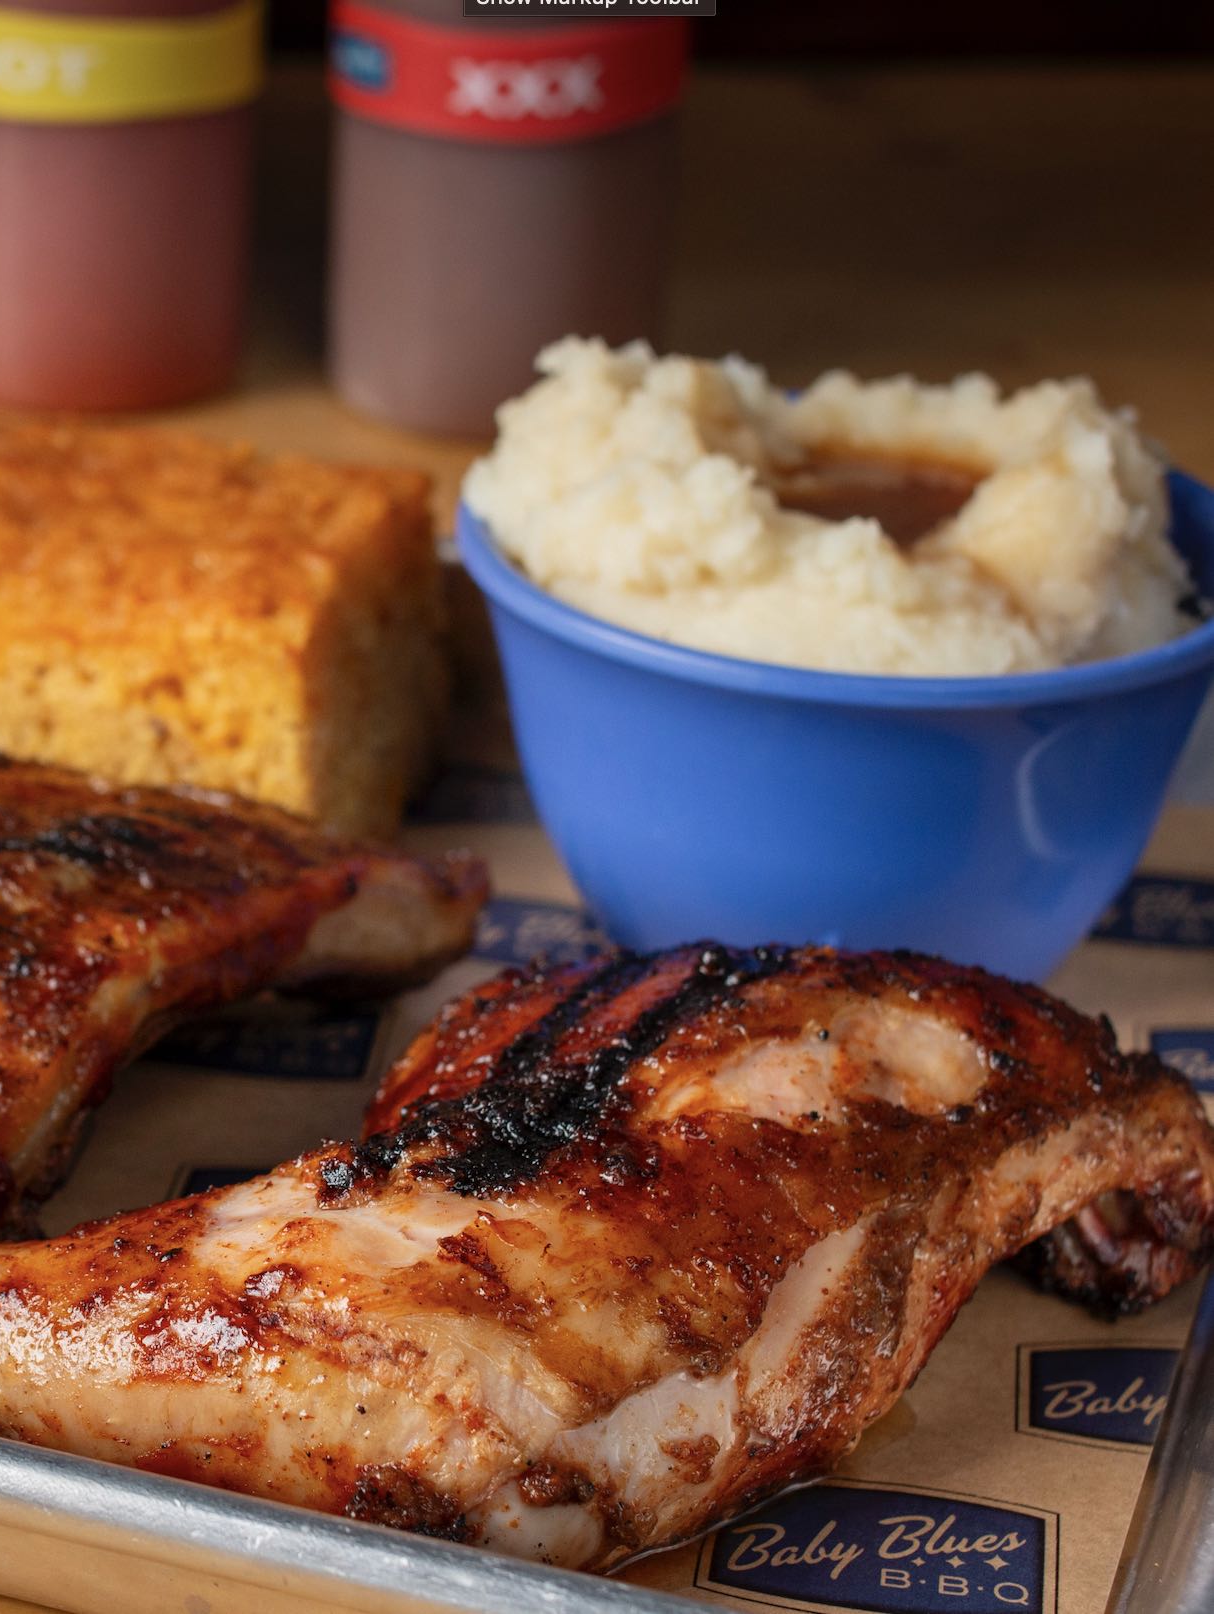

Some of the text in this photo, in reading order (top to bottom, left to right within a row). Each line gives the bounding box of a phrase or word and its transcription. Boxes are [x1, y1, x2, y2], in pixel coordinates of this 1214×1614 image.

[444, 52, 607, 121] XXX
[1042, 1376, 1168, 1425] Baby
[726, 1514, 1027, 1580] Baby Blues
